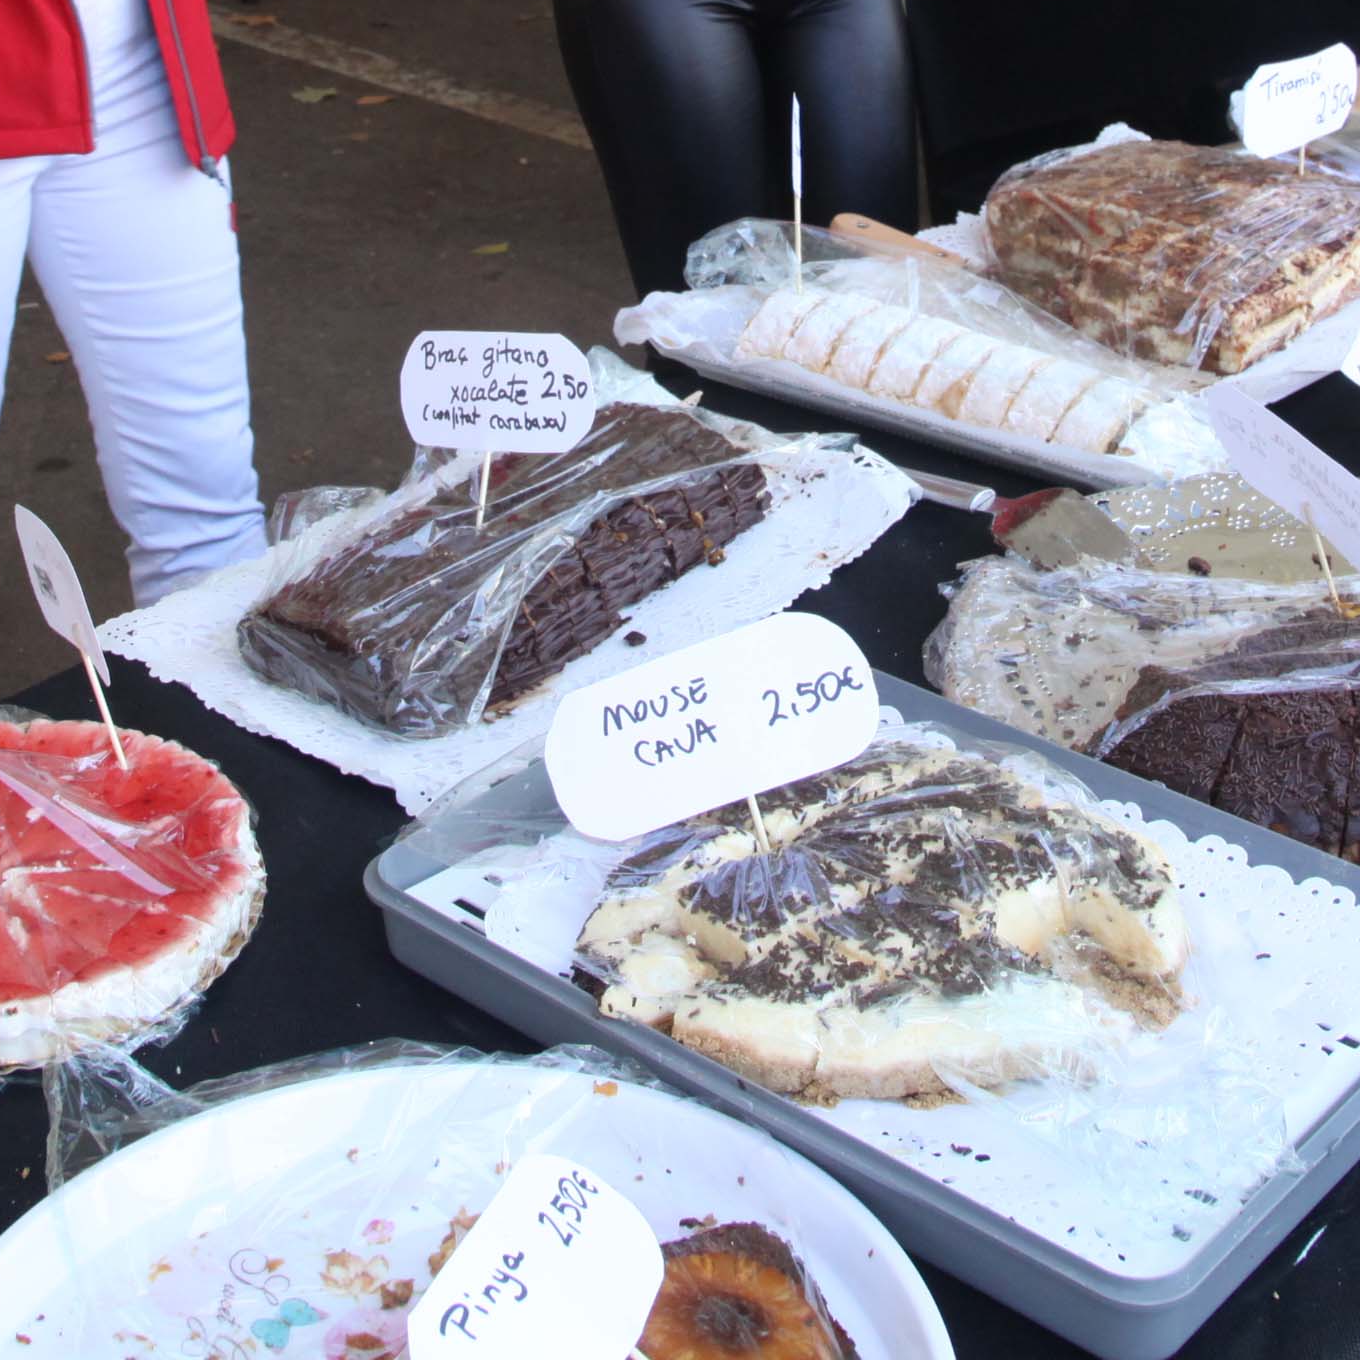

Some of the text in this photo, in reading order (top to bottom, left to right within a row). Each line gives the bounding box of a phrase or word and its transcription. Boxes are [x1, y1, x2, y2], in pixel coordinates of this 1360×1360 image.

[421, 337, 549, 378] Braç gitano
[541, 371, 588, 400] 2,50
[603, 666, 864, 736] MOUSE 2,50€
[634, 718, 718, 767] CAVA
[439, 1251, 528, 1340] Pinya
